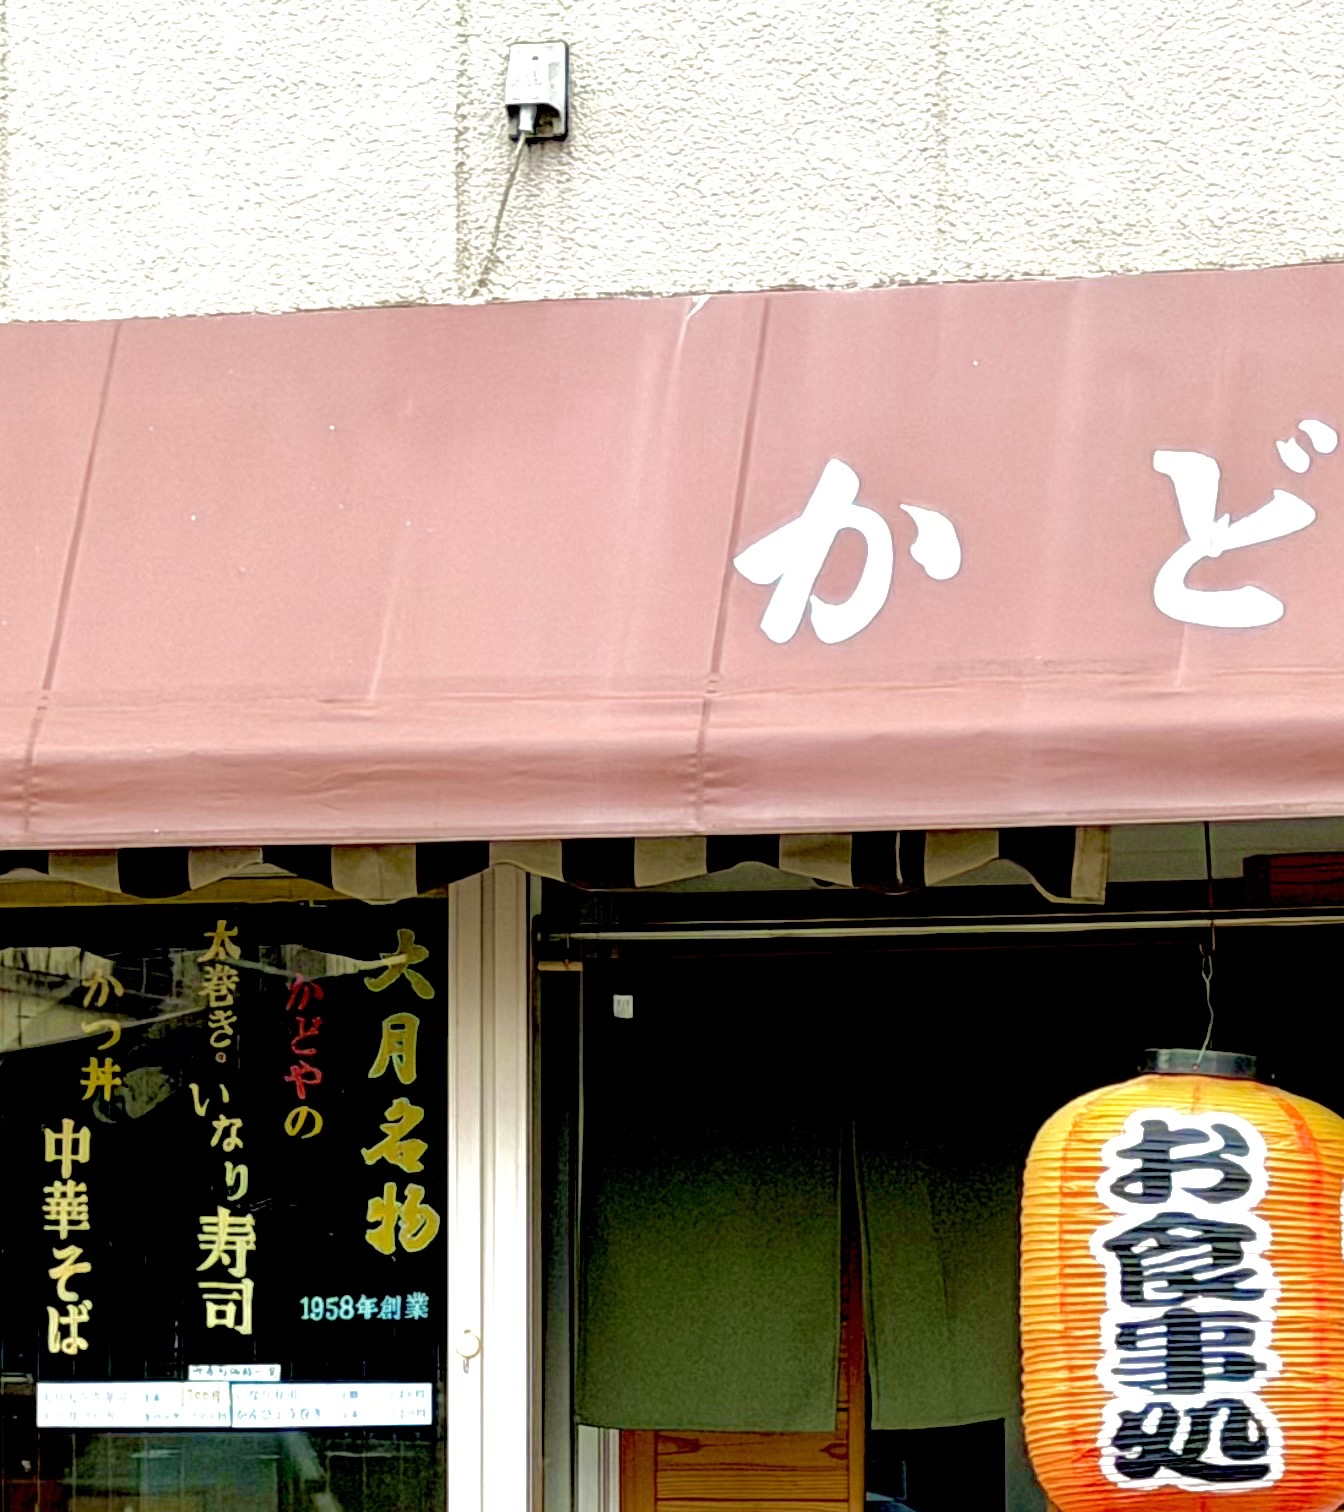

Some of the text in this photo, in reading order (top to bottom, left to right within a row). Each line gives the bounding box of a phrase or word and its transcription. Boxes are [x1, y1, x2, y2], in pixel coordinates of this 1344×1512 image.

[80, 968, 125, 1102] かつ丼
[284, 973, 324, 1139] かどやの
[361, 928, 441, 1255] 大月名物
[42, 1118, 92, 1355] 中華そば
[299, 1292, 430, 1321] 1958年創業
[1102, 1116, 1272, 1485] お食事処
